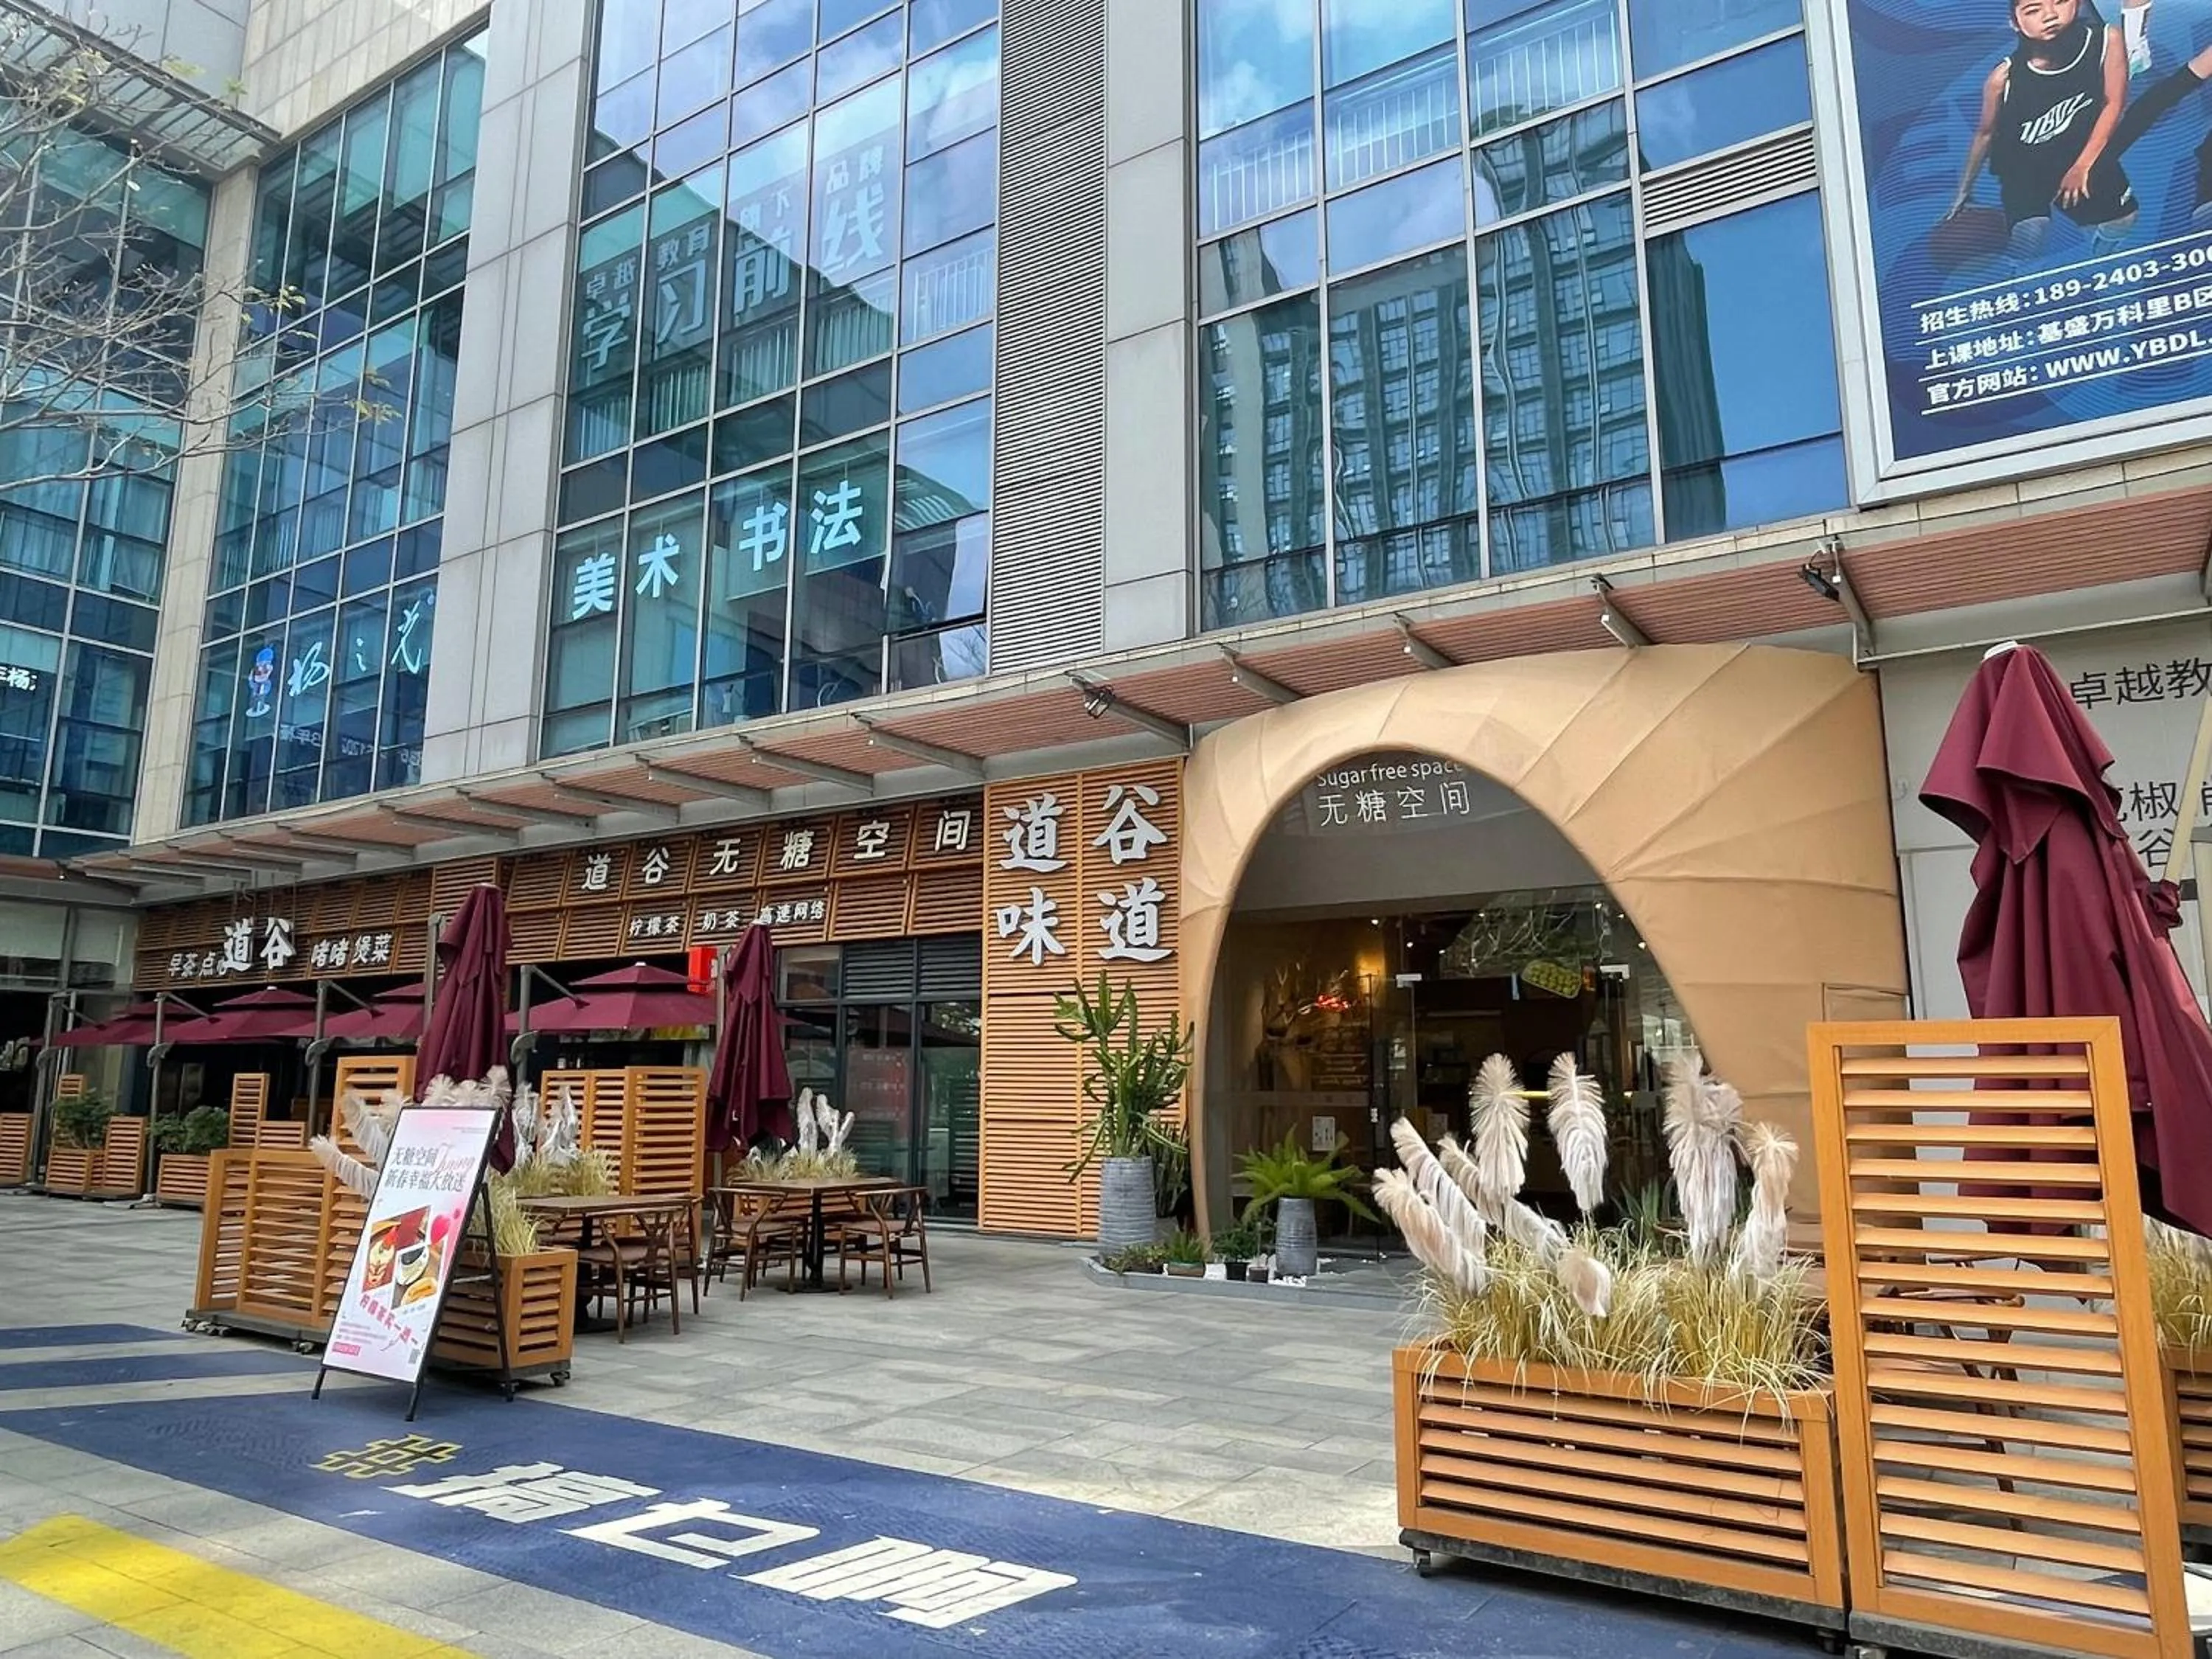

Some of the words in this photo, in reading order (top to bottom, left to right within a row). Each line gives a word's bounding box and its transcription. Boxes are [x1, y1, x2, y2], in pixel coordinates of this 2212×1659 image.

[572, 531, 681, 620] 美术
[738, 480, 863, 572] 书法
[2070, 657, 2212, 709] 卓越教
[1369, 763, 1408, 781] free
[999, 785, 1168, 873] 道谷
[1318, 781, 1470, 827] 无糖空间
[2118, 782, 2179, 822] 椒
[581, 810, 971, 891] 道谷无糖空间
[223, 917, 295, 973] 道谷
[702, 910, 740, 931] 奶茶
[995, 877, 1175, 966] 味道
